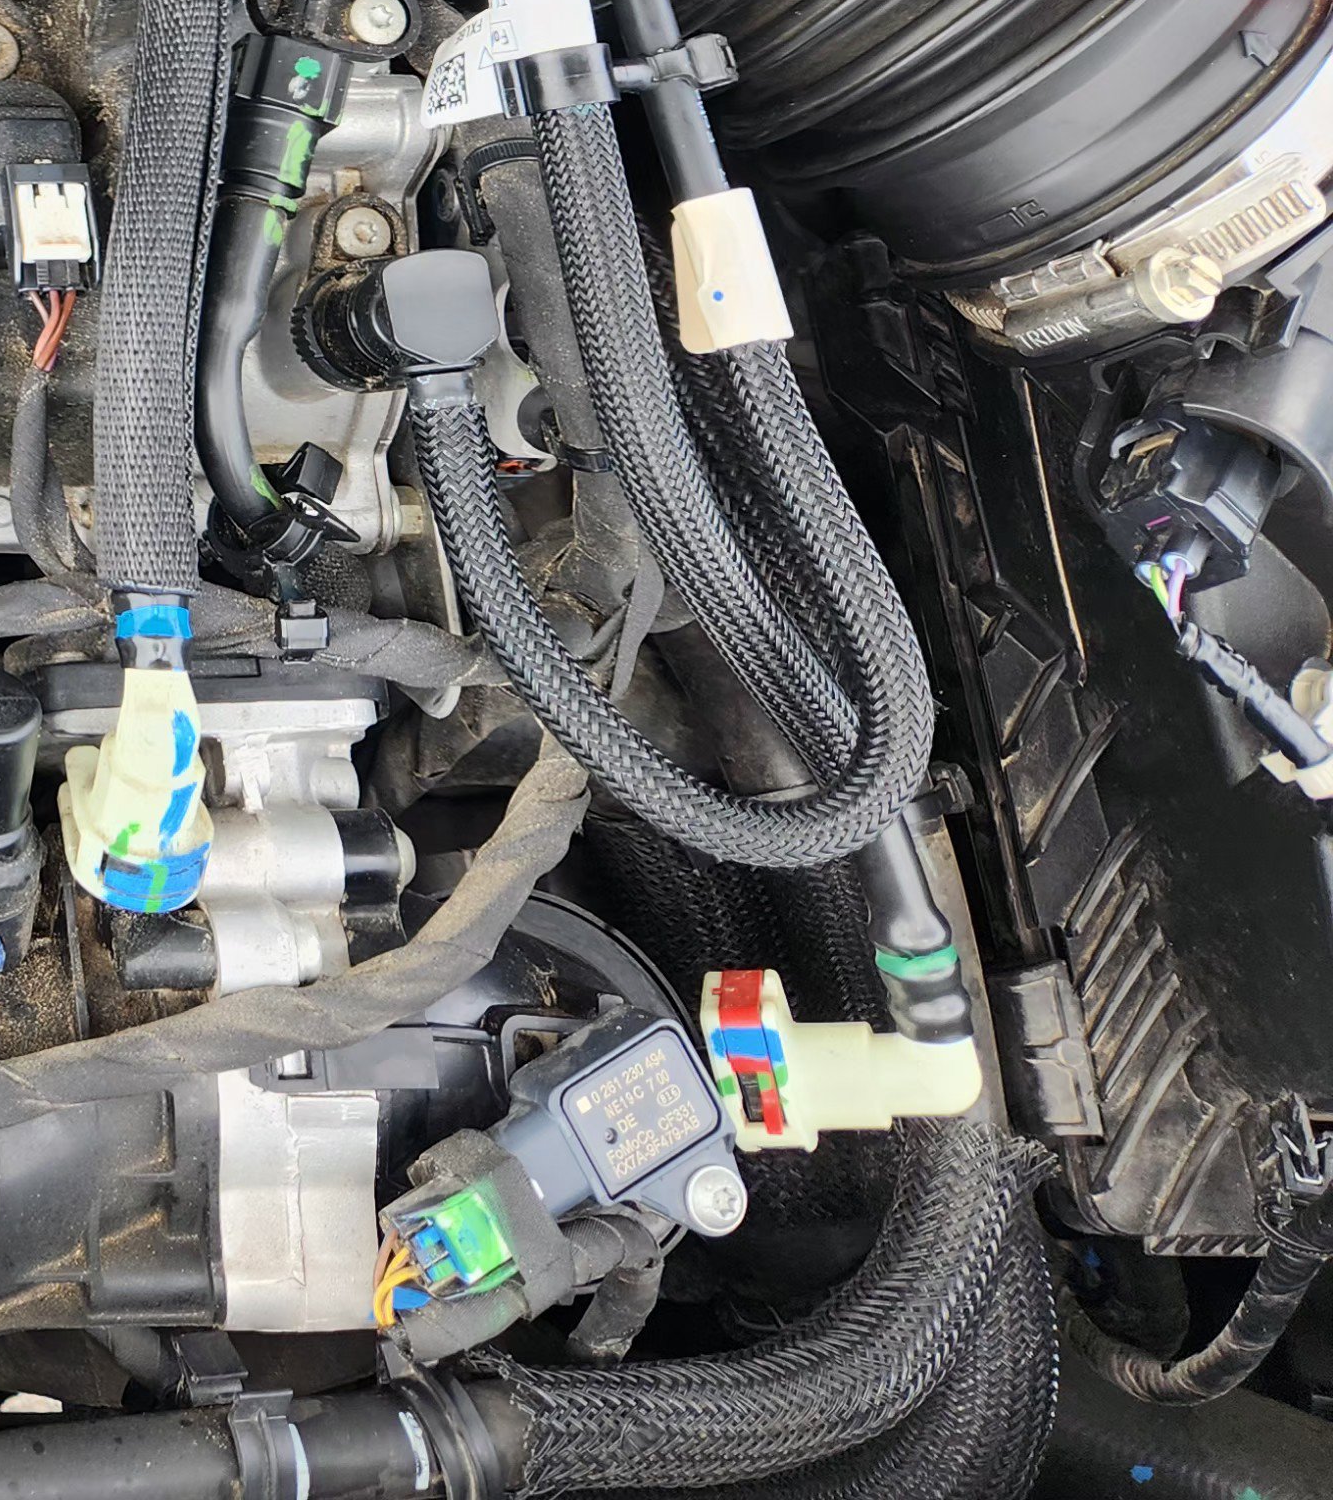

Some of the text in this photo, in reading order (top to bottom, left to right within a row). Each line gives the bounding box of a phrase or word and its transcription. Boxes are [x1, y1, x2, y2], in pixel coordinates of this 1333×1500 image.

[1014, 316, 1091, 350] TRIDON
[590, 1048, 667, 1104] 0 261 230 494
[645, 1078, 655, 1093] 7
[606, 1101, 696, 1166] FoMoCo CF331
[616, 1113, 638, 1134] DE
[614, 1114, 701, 1179] KX7A-9F479-AB
